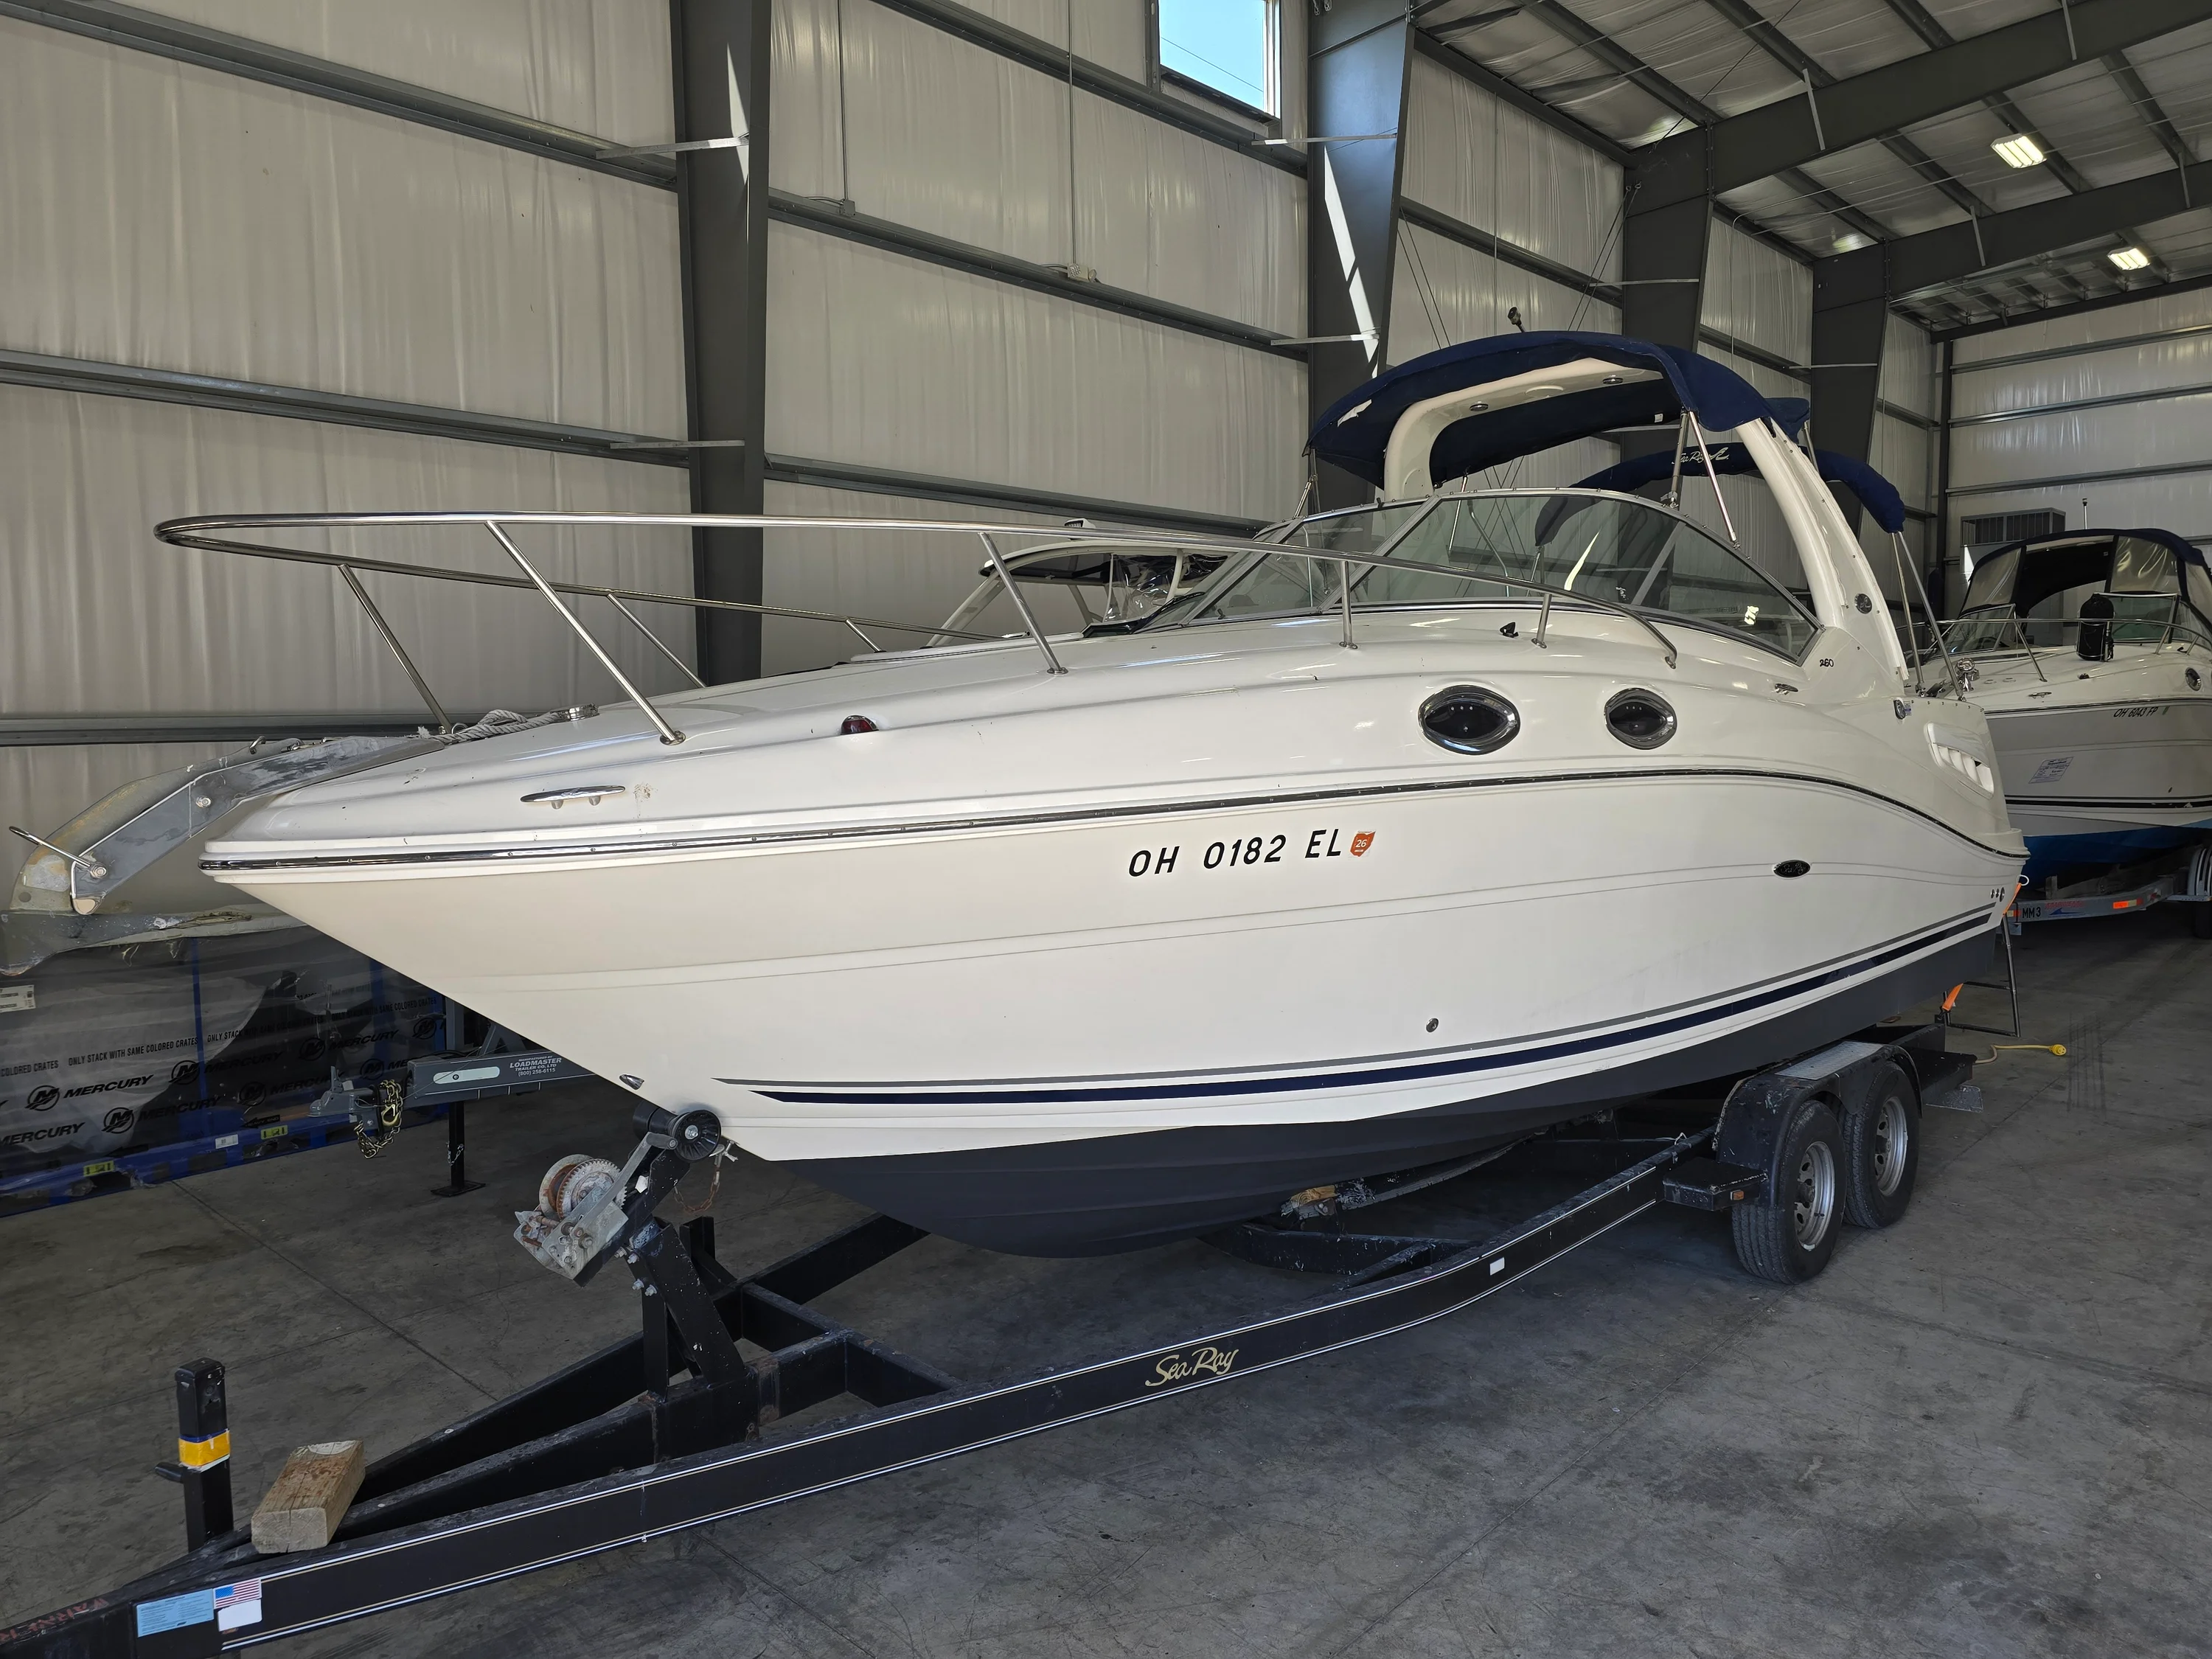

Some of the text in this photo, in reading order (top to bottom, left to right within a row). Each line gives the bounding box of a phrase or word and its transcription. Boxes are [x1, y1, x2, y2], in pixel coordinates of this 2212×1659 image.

[1820, 658, 1834, 667] 260
[2114, 708, 2129, 717] OH
[1128, 828, 1341, 877] OH 0182 EL
[1355, 839, 1368, 848] 26
[394, 1001, 417, 1011] COLORED
[419, 997, 437, 1007] CRATES
[207, 1033, 223, 1043] ONLY
[328, 1029, 399, 1050] MERCURY
[69, 1037, 198, 1066] ONLY STACK WITH SAME COLORED CRATES
[1, 1060, 59, 1077] COLORED CRATES
[204, 1051, 283, 1073] MERCURY
[509, 1057, 562, 1068] LOADMASTER
[63, 1074, 154, 1099] MERCURY
[138, 1096, 222, 1121] MERCURY
[1145, 1346, 1239, 1386] Sea Ray
